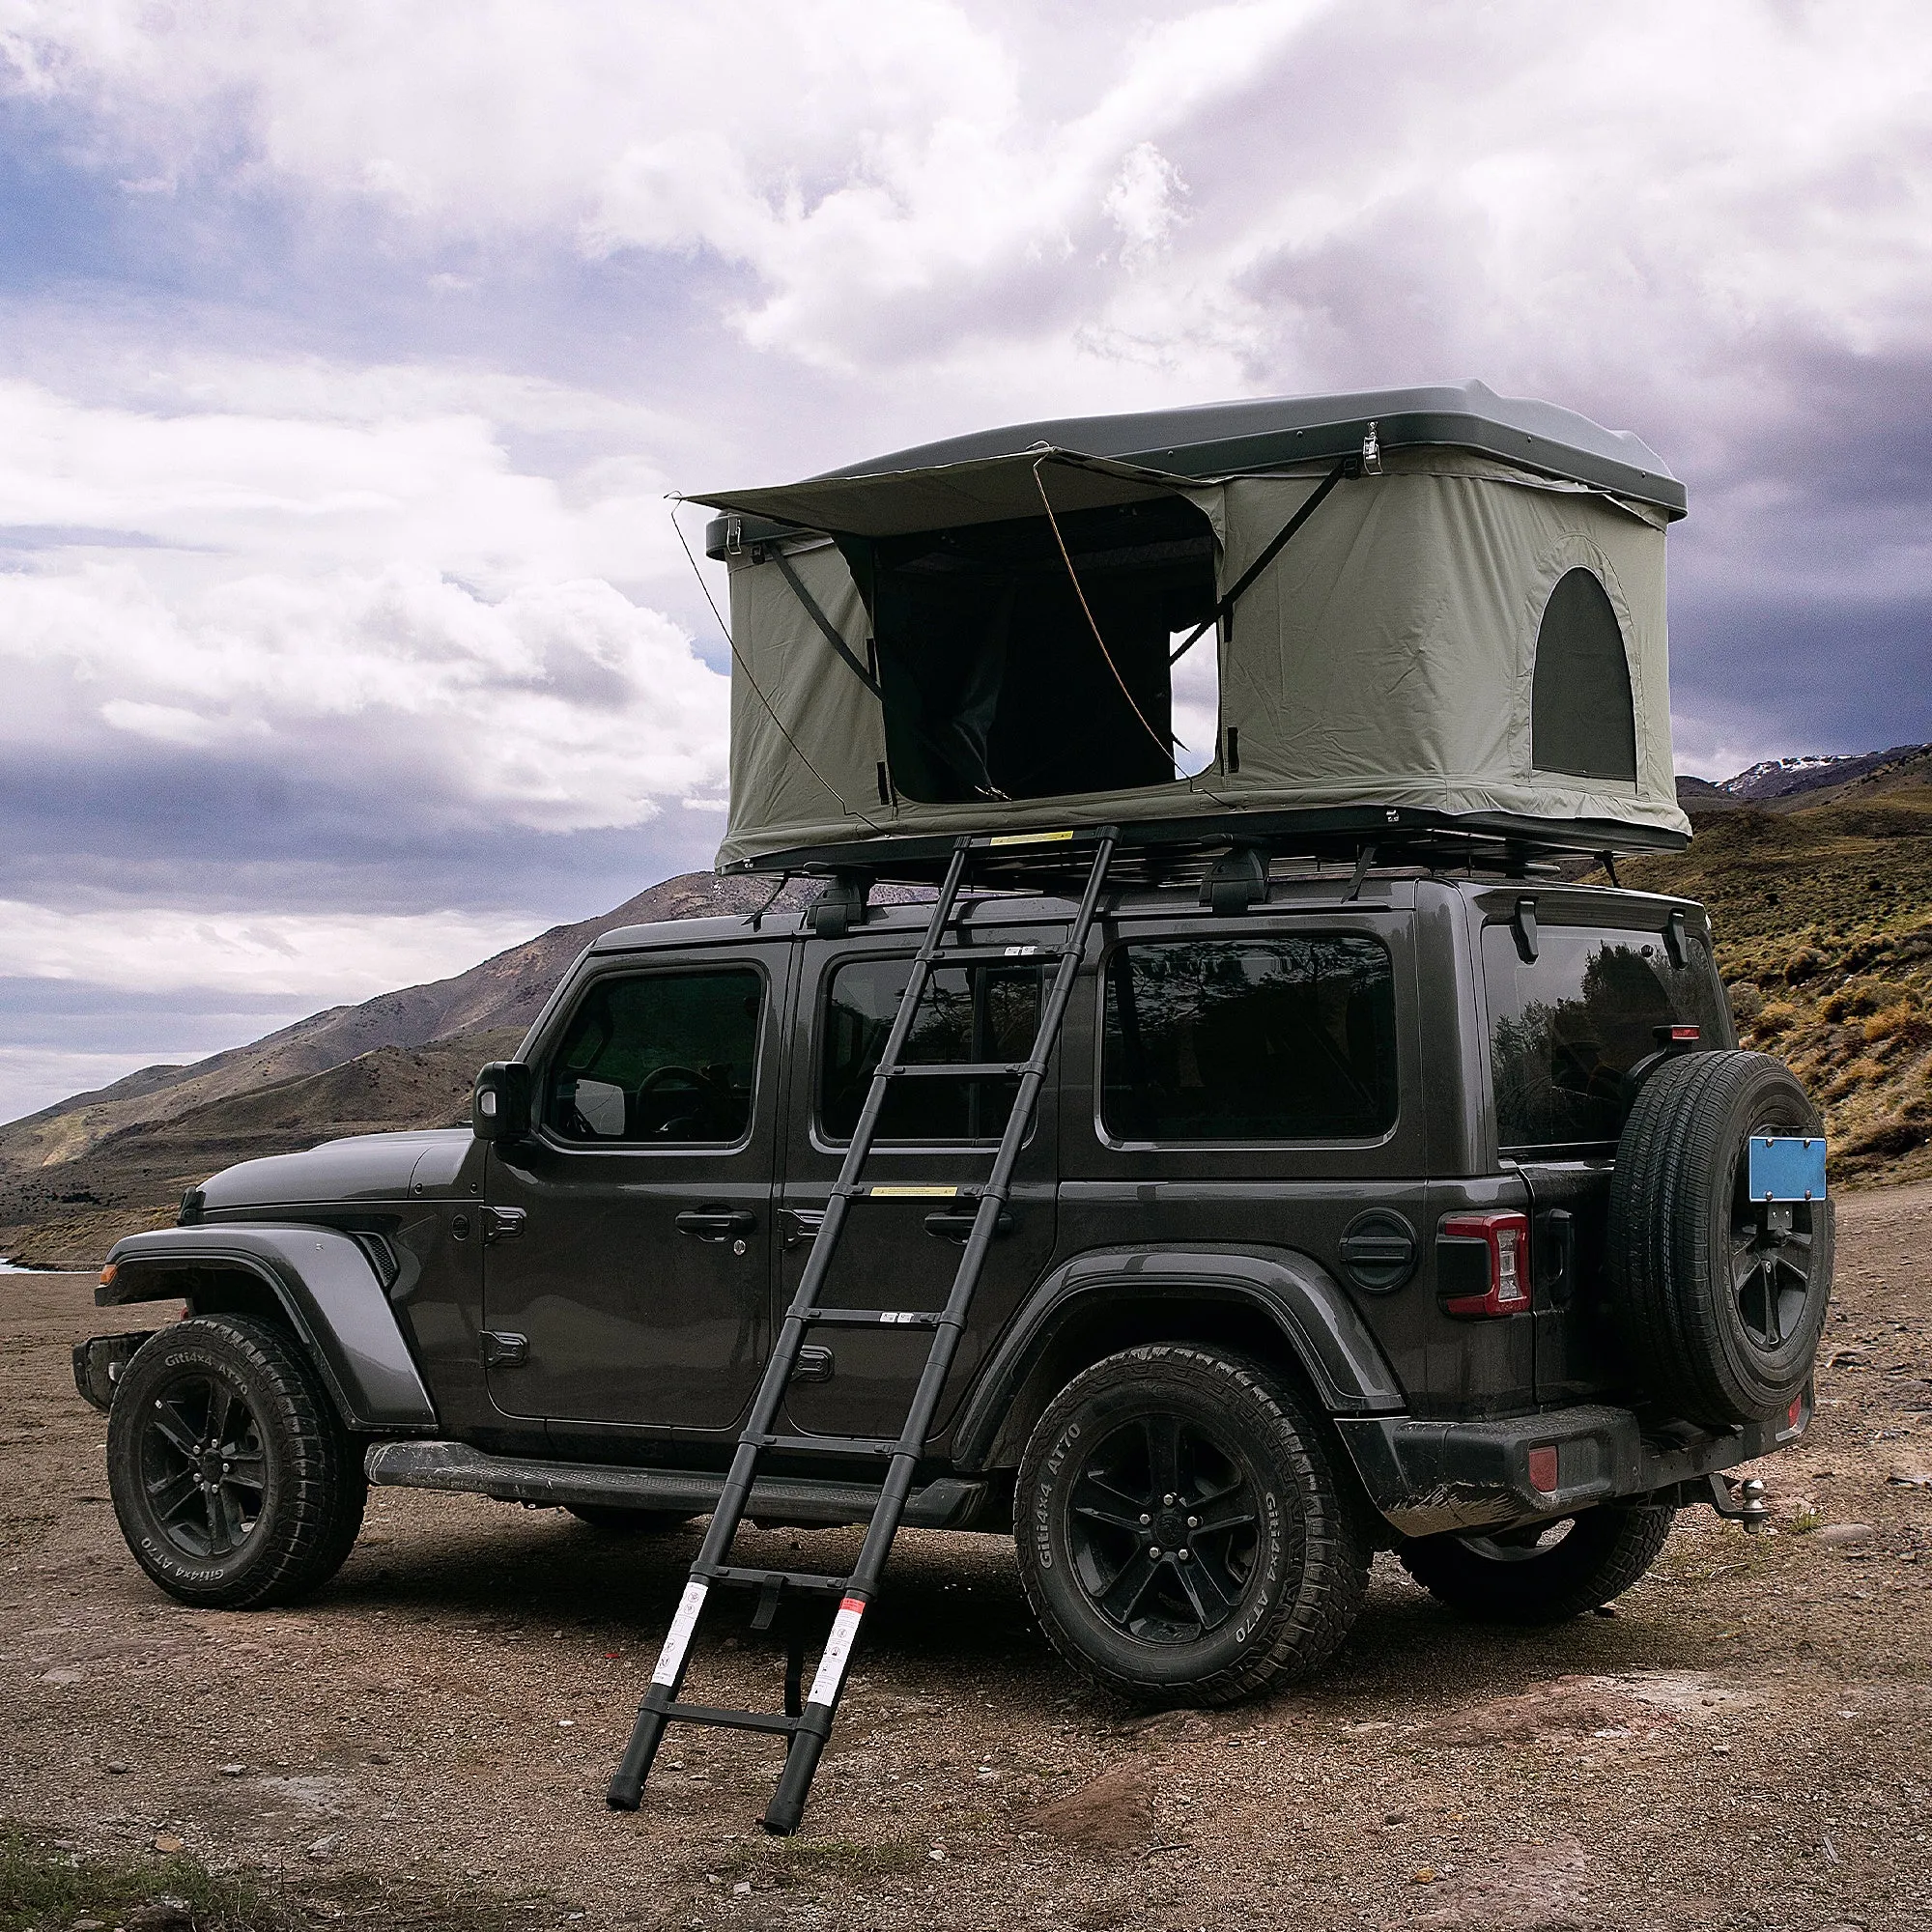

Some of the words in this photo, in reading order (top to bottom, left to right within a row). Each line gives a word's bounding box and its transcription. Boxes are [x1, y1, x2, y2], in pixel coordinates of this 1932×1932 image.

[164, 1352, 213, 1367] Giti4x4
[218, 1363, 248, 1395] AT70
[1037, 1483, 1052, 1569] Giti4x4
[1047, 1423, 1081, 1476] AT70
[141, 1537, 174, 1570] AT70
[1265, 1492, 1281, 1582] Giti4x4
[175, 1566, 224, 1582] Giti4x4
[1236, 1589, 1268, 1643] AT70
